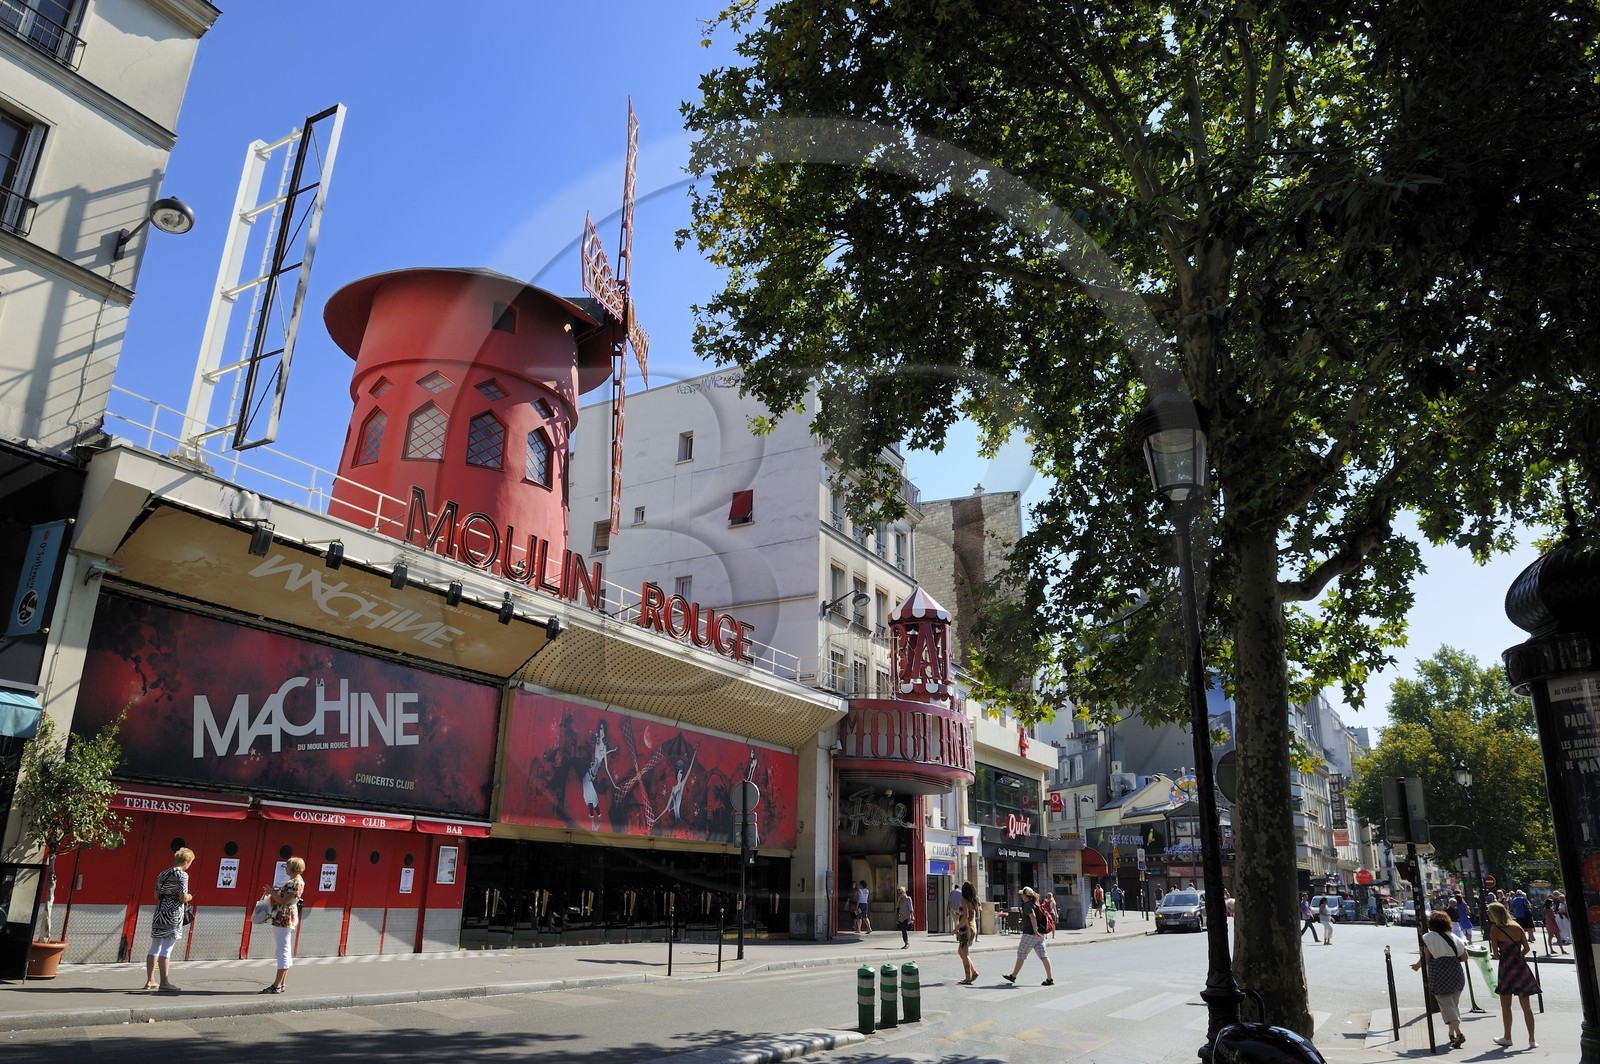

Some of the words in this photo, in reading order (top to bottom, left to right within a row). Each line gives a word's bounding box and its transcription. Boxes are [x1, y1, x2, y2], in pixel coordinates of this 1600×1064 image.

[404, 485, 603, 611] MOULIN
[640, 581, 755, 663] ROUGE
[193, 676, 420, 759] MACHINE
[1563, 712, 1591, 728] PAUL
[307, 742, 329, 751] MOULIN
[330, 741, 348, 750] ROUGE
[1560, 740, 1572, 750] LES
[355, 773, 395, 788] CONCERTS
[396, 779, 415, 791] CLUB
[124, 796, 191, 814] TERRASSE
[1327, 774, 1343, 820] MUSEE
[293, 809, 346, 824] CONCERTS
[362, 816, 387, 829] CLUB
[1008, 813, 1032, 839] Quick
[446, 824, 463, 835] BAR
